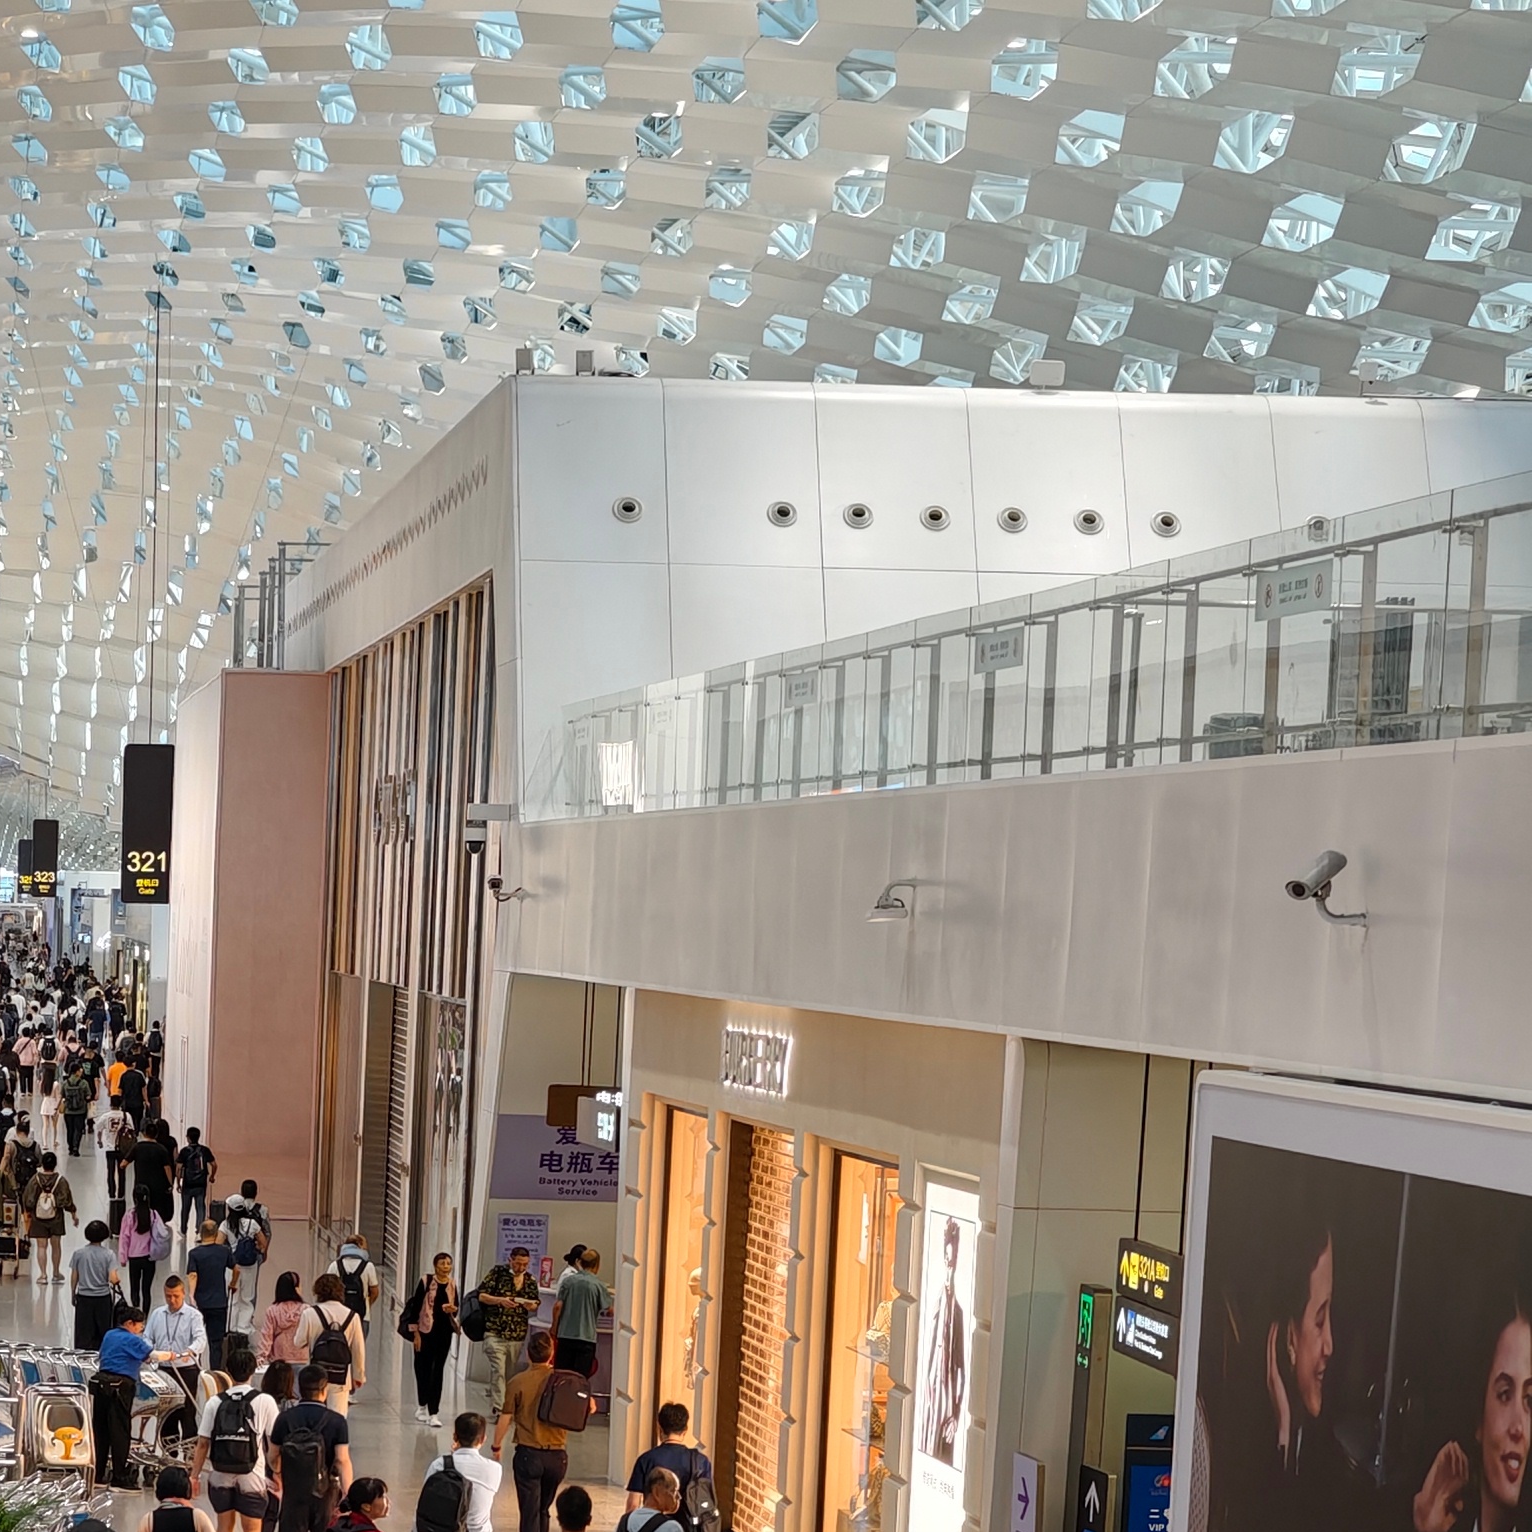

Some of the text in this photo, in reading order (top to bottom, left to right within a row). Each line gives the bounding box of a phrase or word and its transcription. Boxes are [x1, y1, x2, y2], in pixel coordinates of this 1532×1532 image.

[126, 851, 166, 872] 321
[33, 871, 55, 882] 323
[539, 1150, 619, 1175] 电瓶车
[539, 1177, 577, 1187] Battery
[558, 1187, 598, 1196] Service
[1148, 1524, 1165, 1532] VIP
